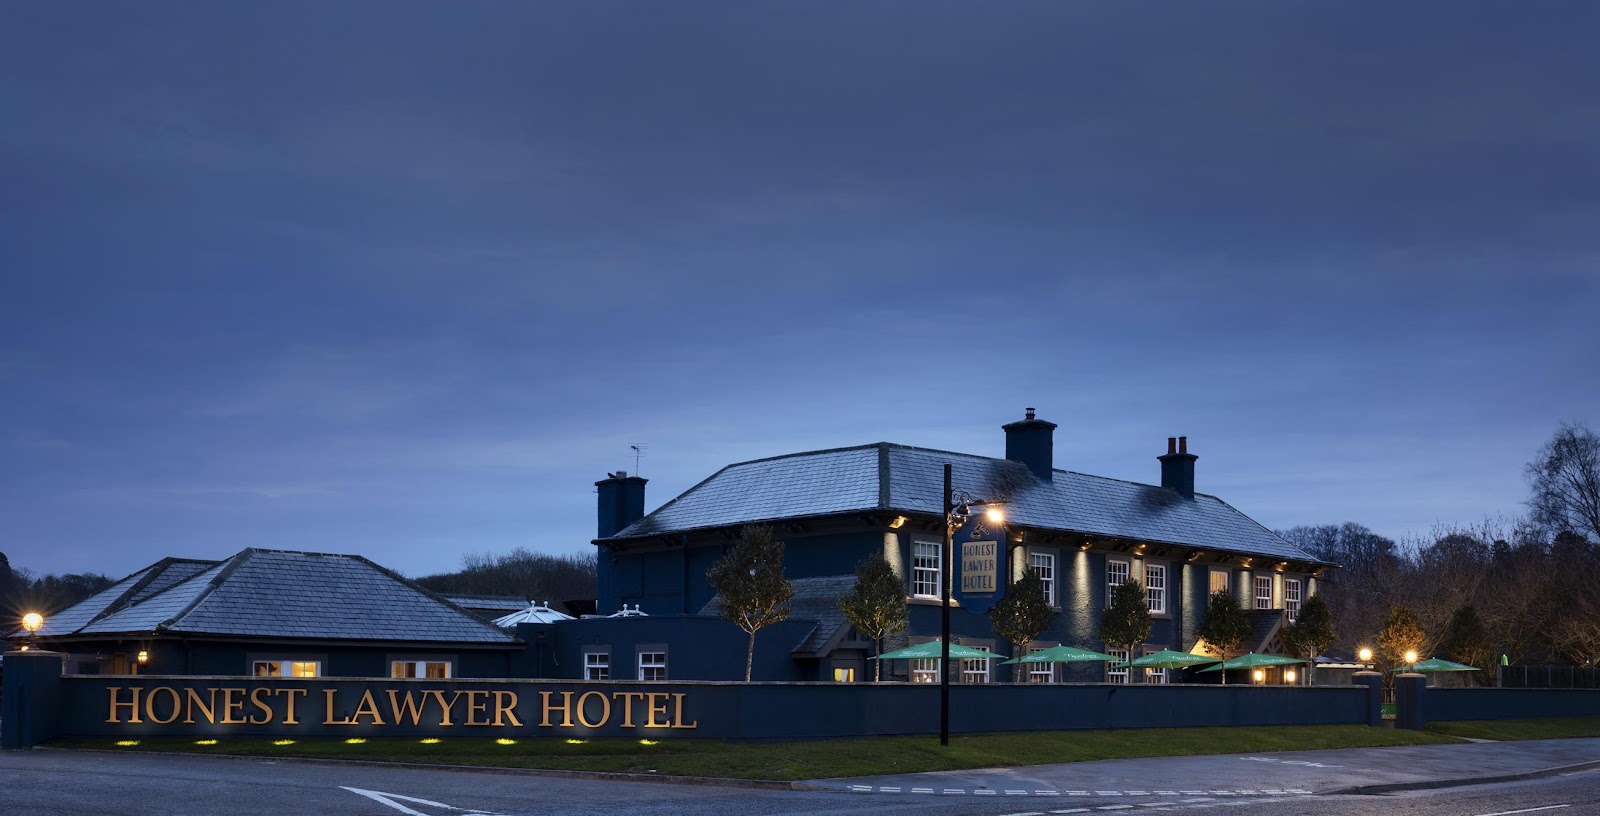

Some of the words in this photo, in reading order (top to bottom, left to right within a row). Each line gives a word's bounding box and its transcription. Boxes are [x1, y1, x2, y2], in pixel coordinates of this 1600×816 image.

[963, 544, 995, 557] HONEST
[963, 559, 995, 572] LAWYER
[963, 575, 994, 590] HOTEL
[105, 687, 307, 725] HONEST
[322, 688, 524, 728] LAWYER
[538, 691, 698, 730] HOTEL
